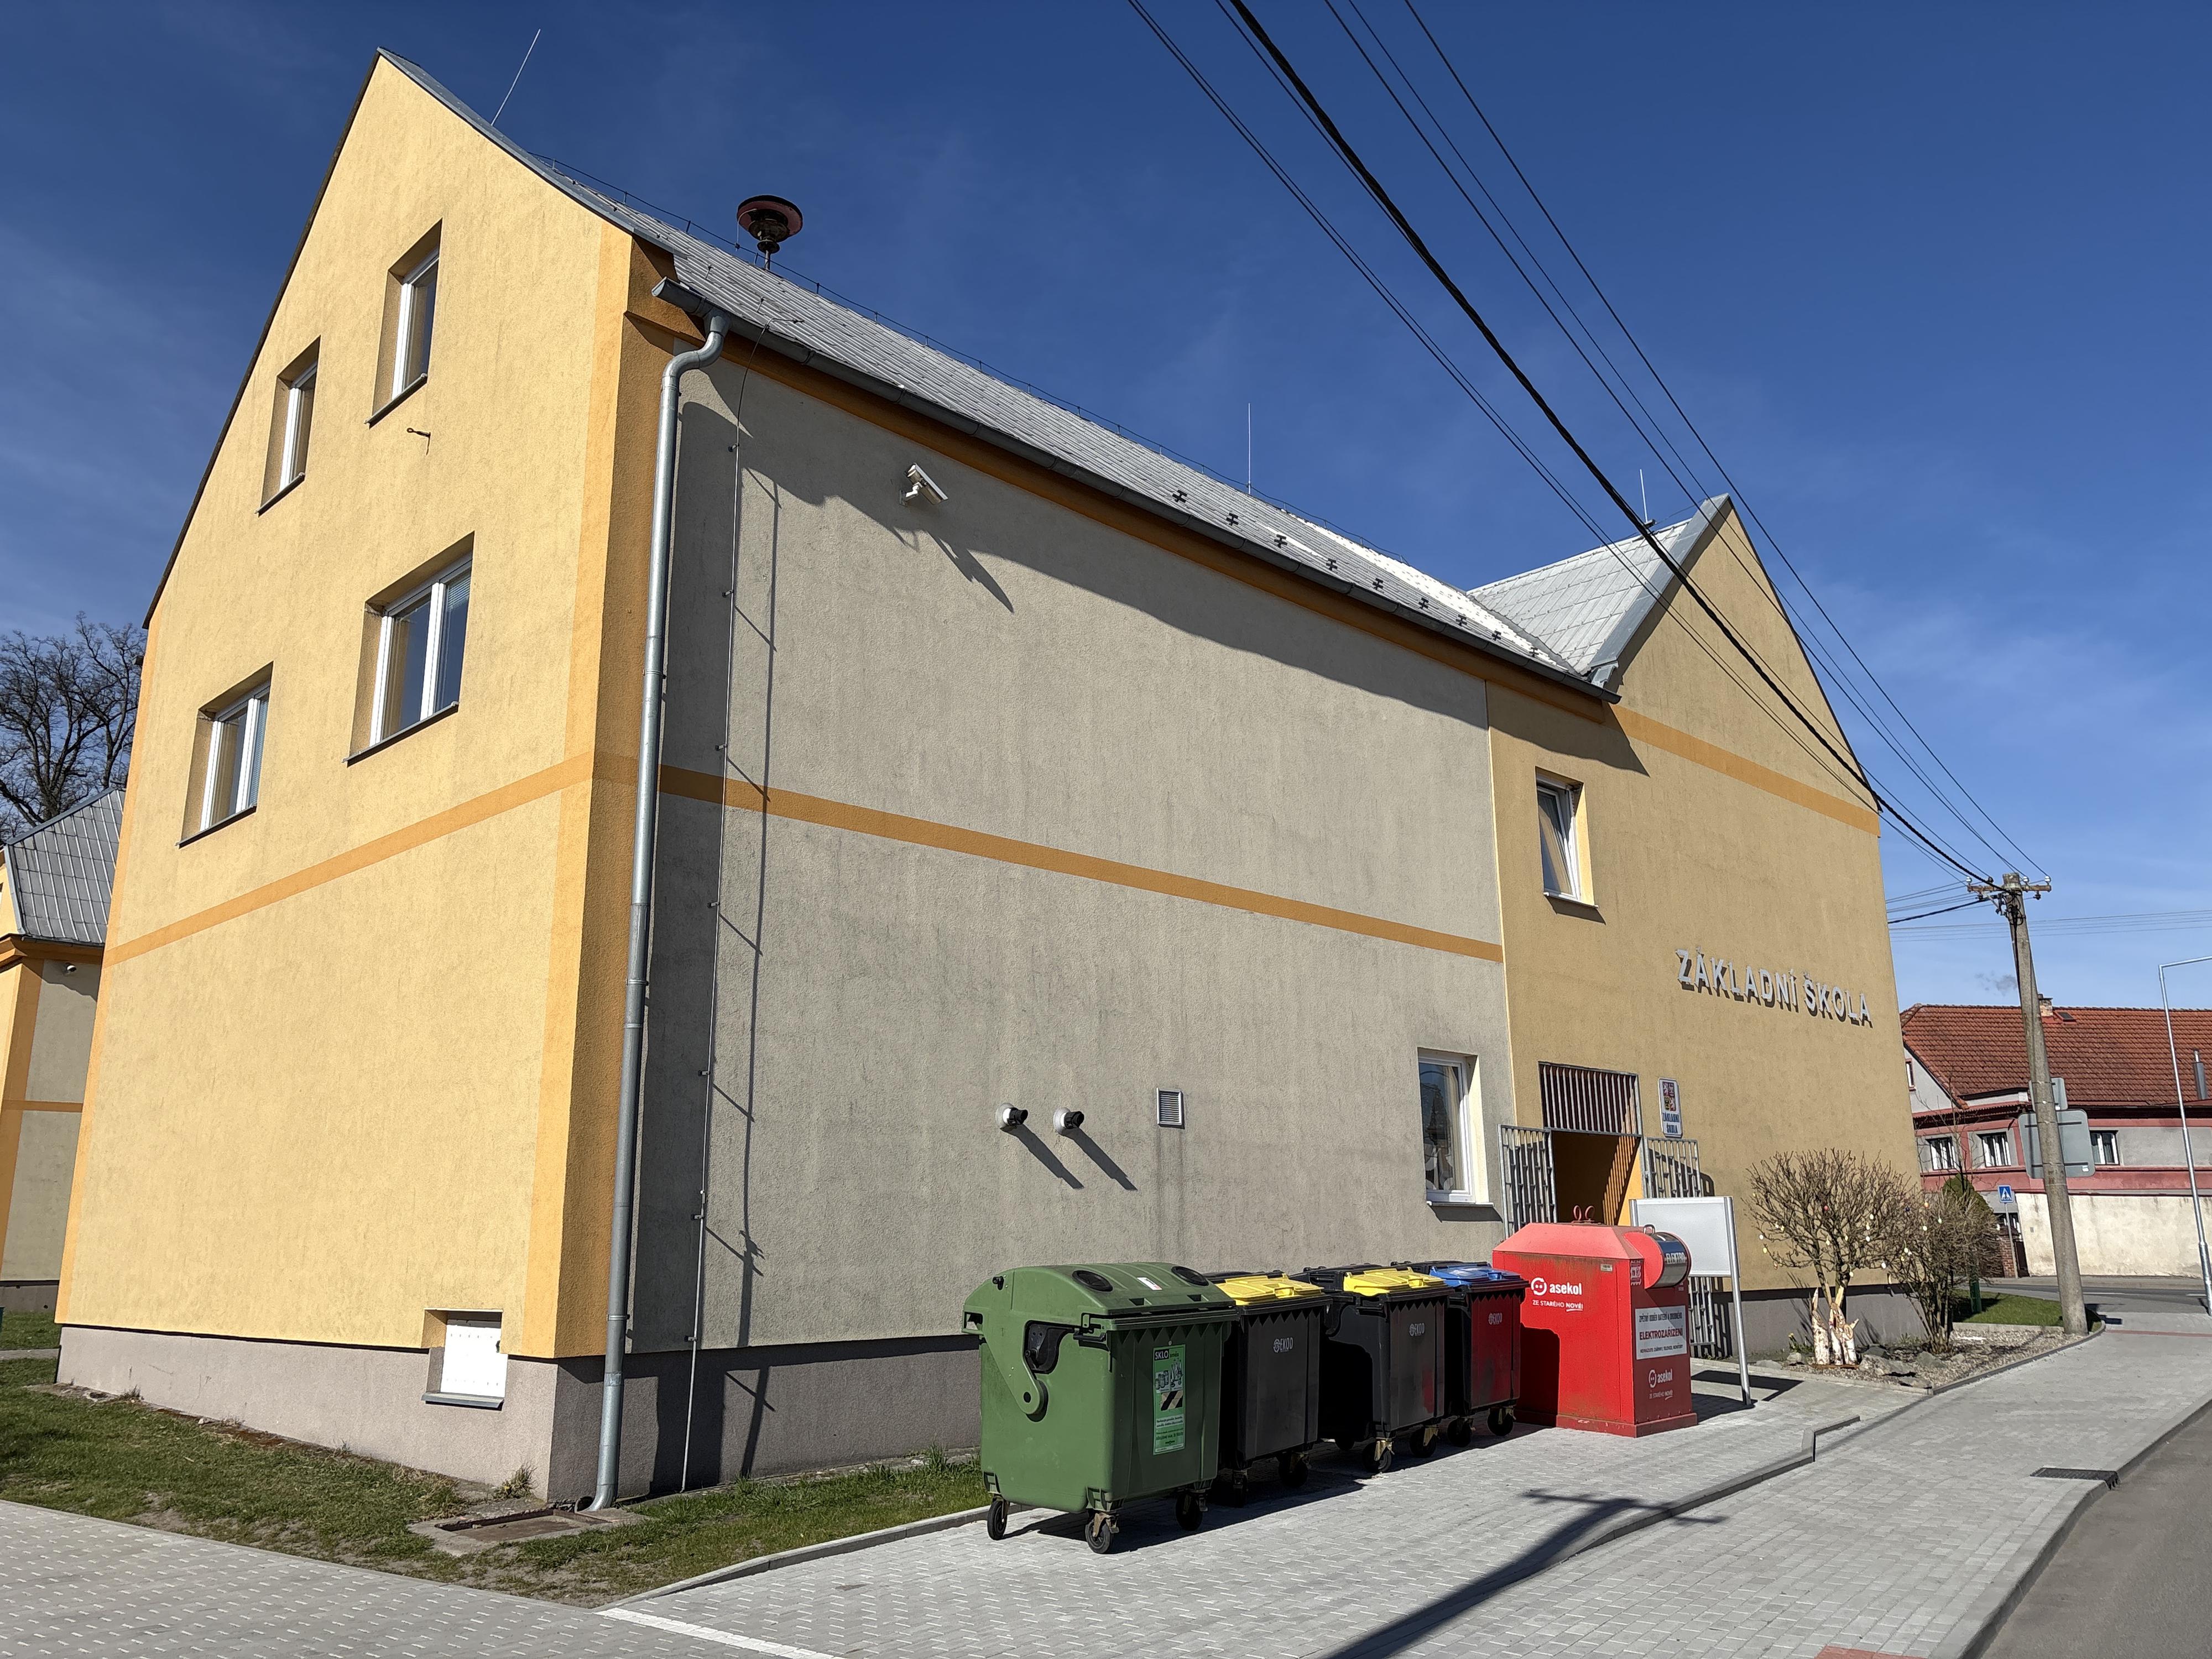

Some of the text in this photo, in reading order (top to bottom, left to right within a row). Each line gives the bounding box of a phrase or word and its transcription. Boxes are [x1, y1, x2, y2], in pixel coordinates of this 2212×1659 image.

[1675, 946, 1871, 1022] ZÁKLADNÍ ŠKOLA
[1666, 1252, 1685, 1265] ELEKTRO
[1549, 1282, 1582, 1295] asekol
[1639, 1326, 1683, 1340] ELEKTROZAŘÍZENÍ
[1280, 1337, 1293, 1350] EKOD
[1155, 1350, 1168, 1360] SKLO
